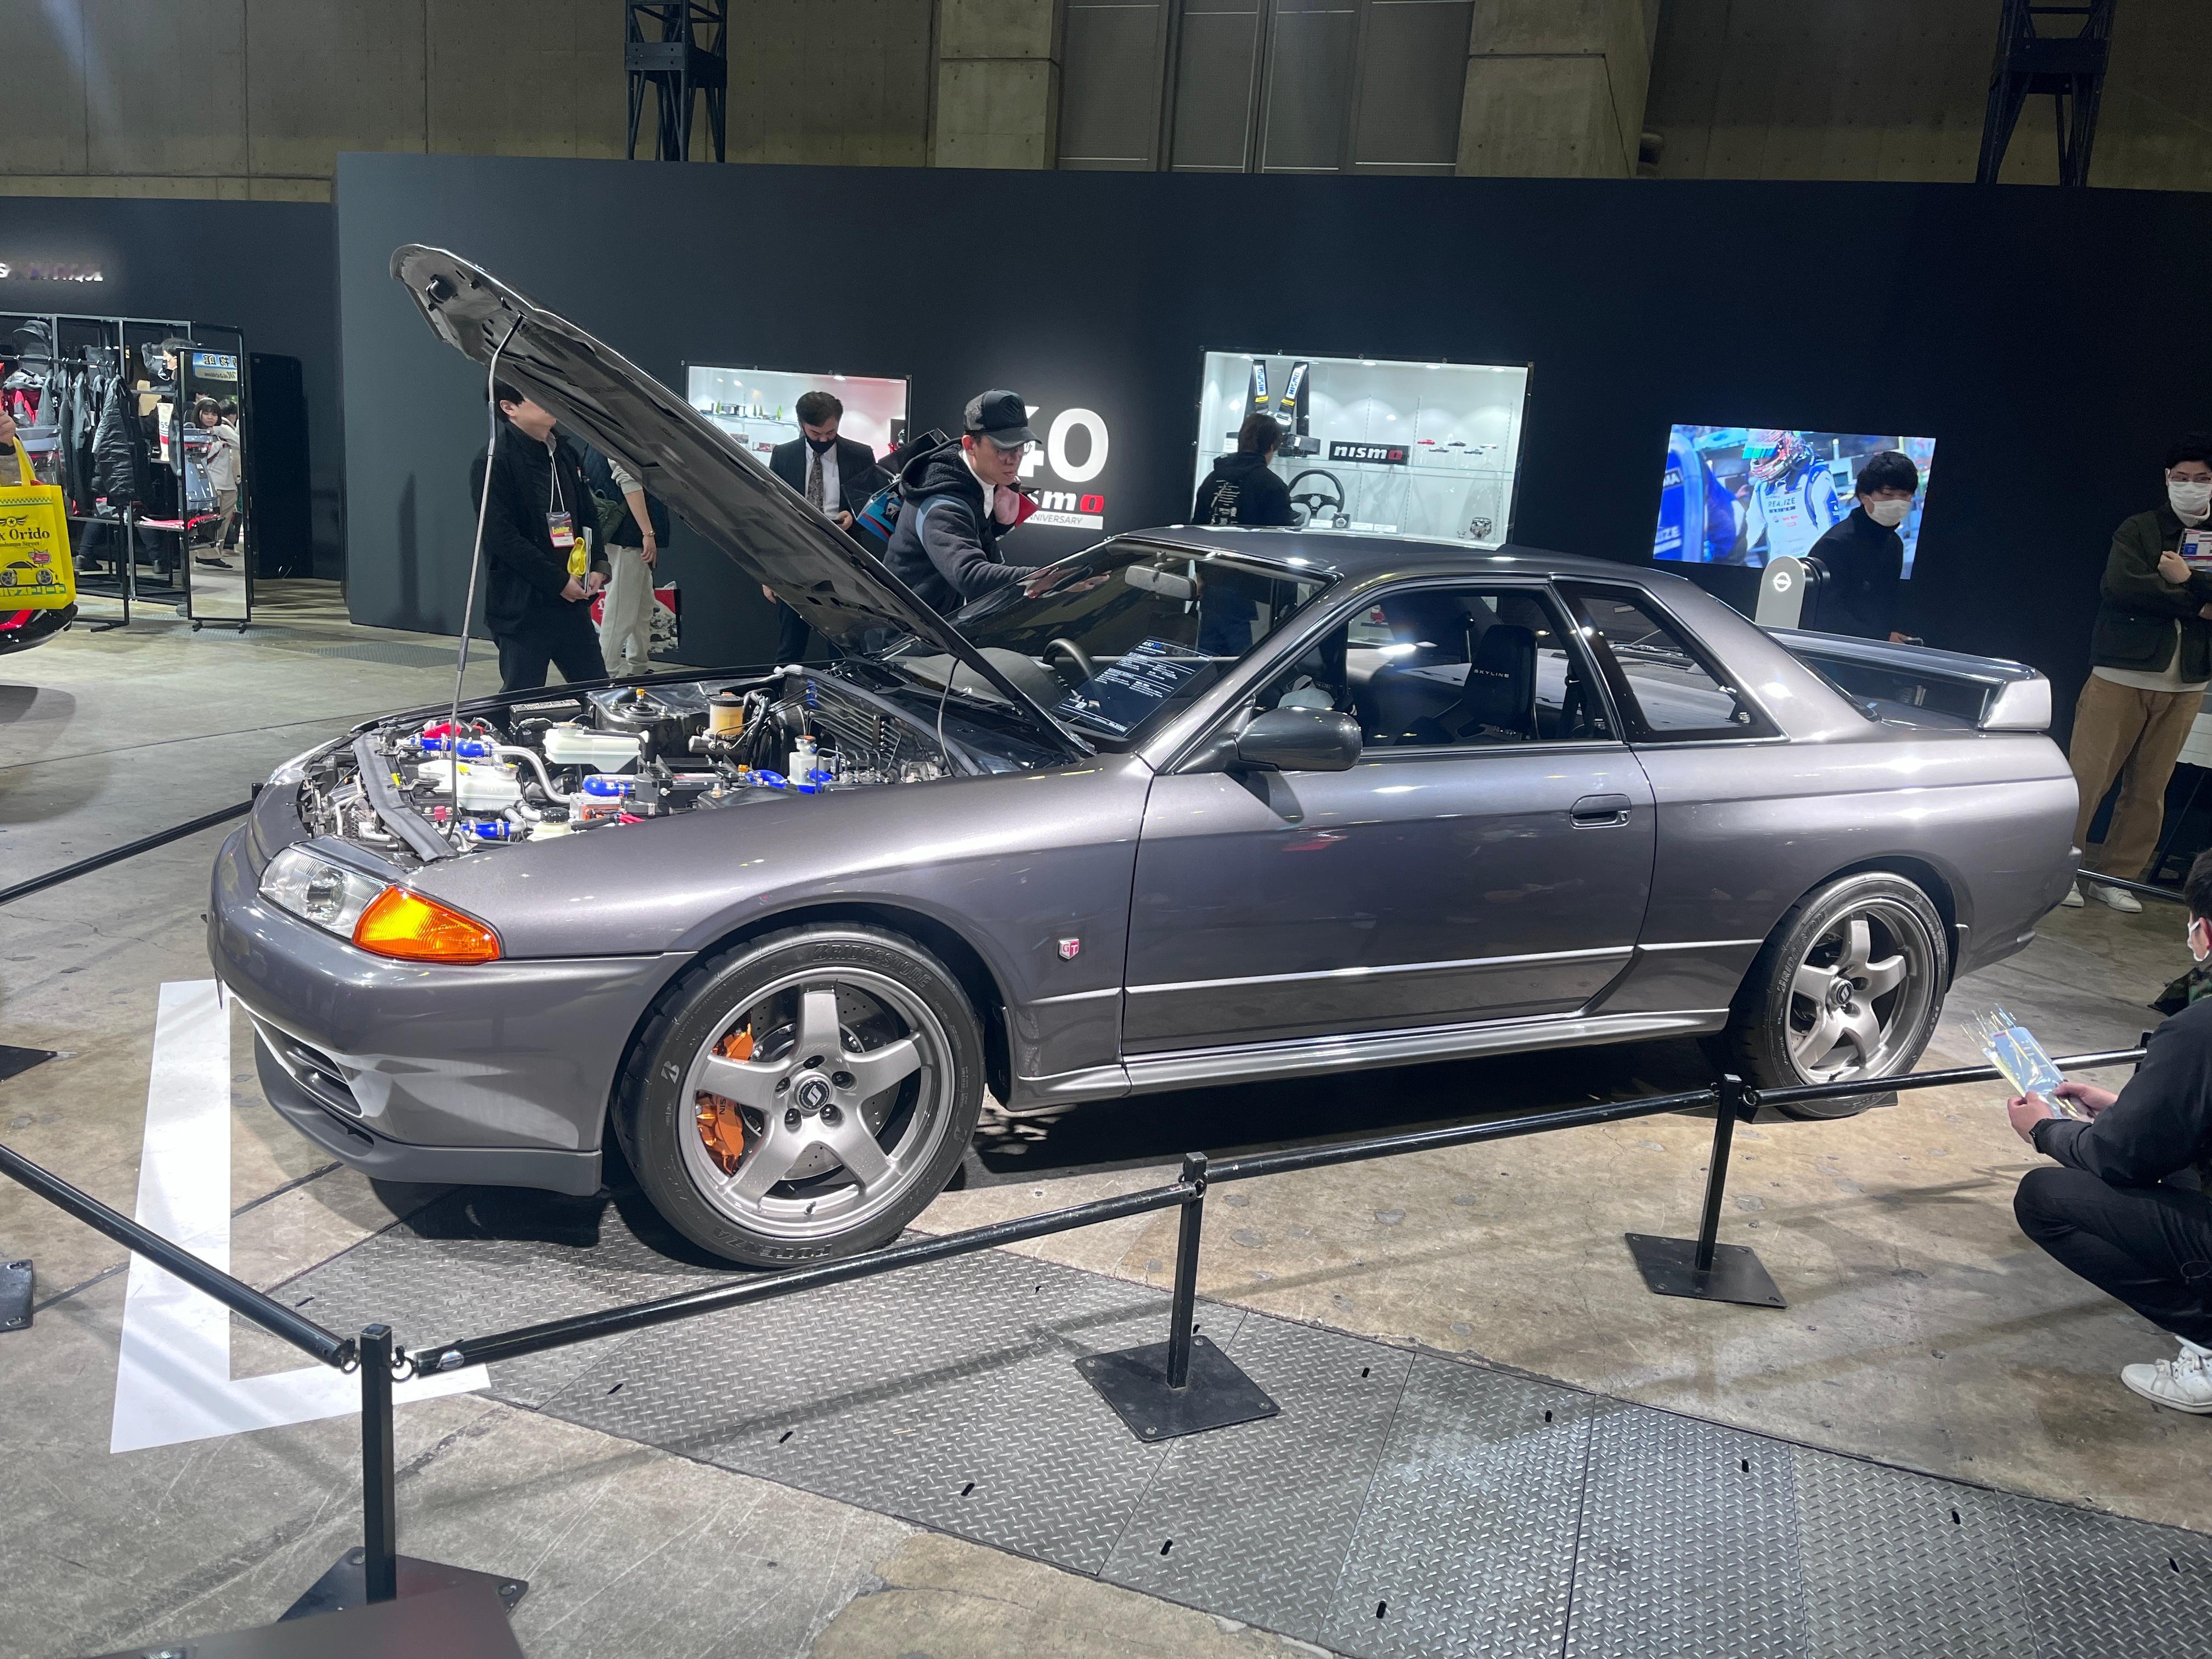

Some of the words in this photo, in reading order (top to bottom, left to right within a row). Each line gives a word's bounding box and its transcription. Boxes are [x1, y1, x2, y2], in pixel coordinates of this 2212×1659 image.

[1334, 446, 1403, 460] nismo
[9, 527, 50, 540] Orido
[1474, 669, 1510, 679] SKYLINE
[1063, 944, 1078, 955] GT
[812, 943, 932, 988] BRIDGESTONE
[713, 1225, 833, 1260] POTENZA
